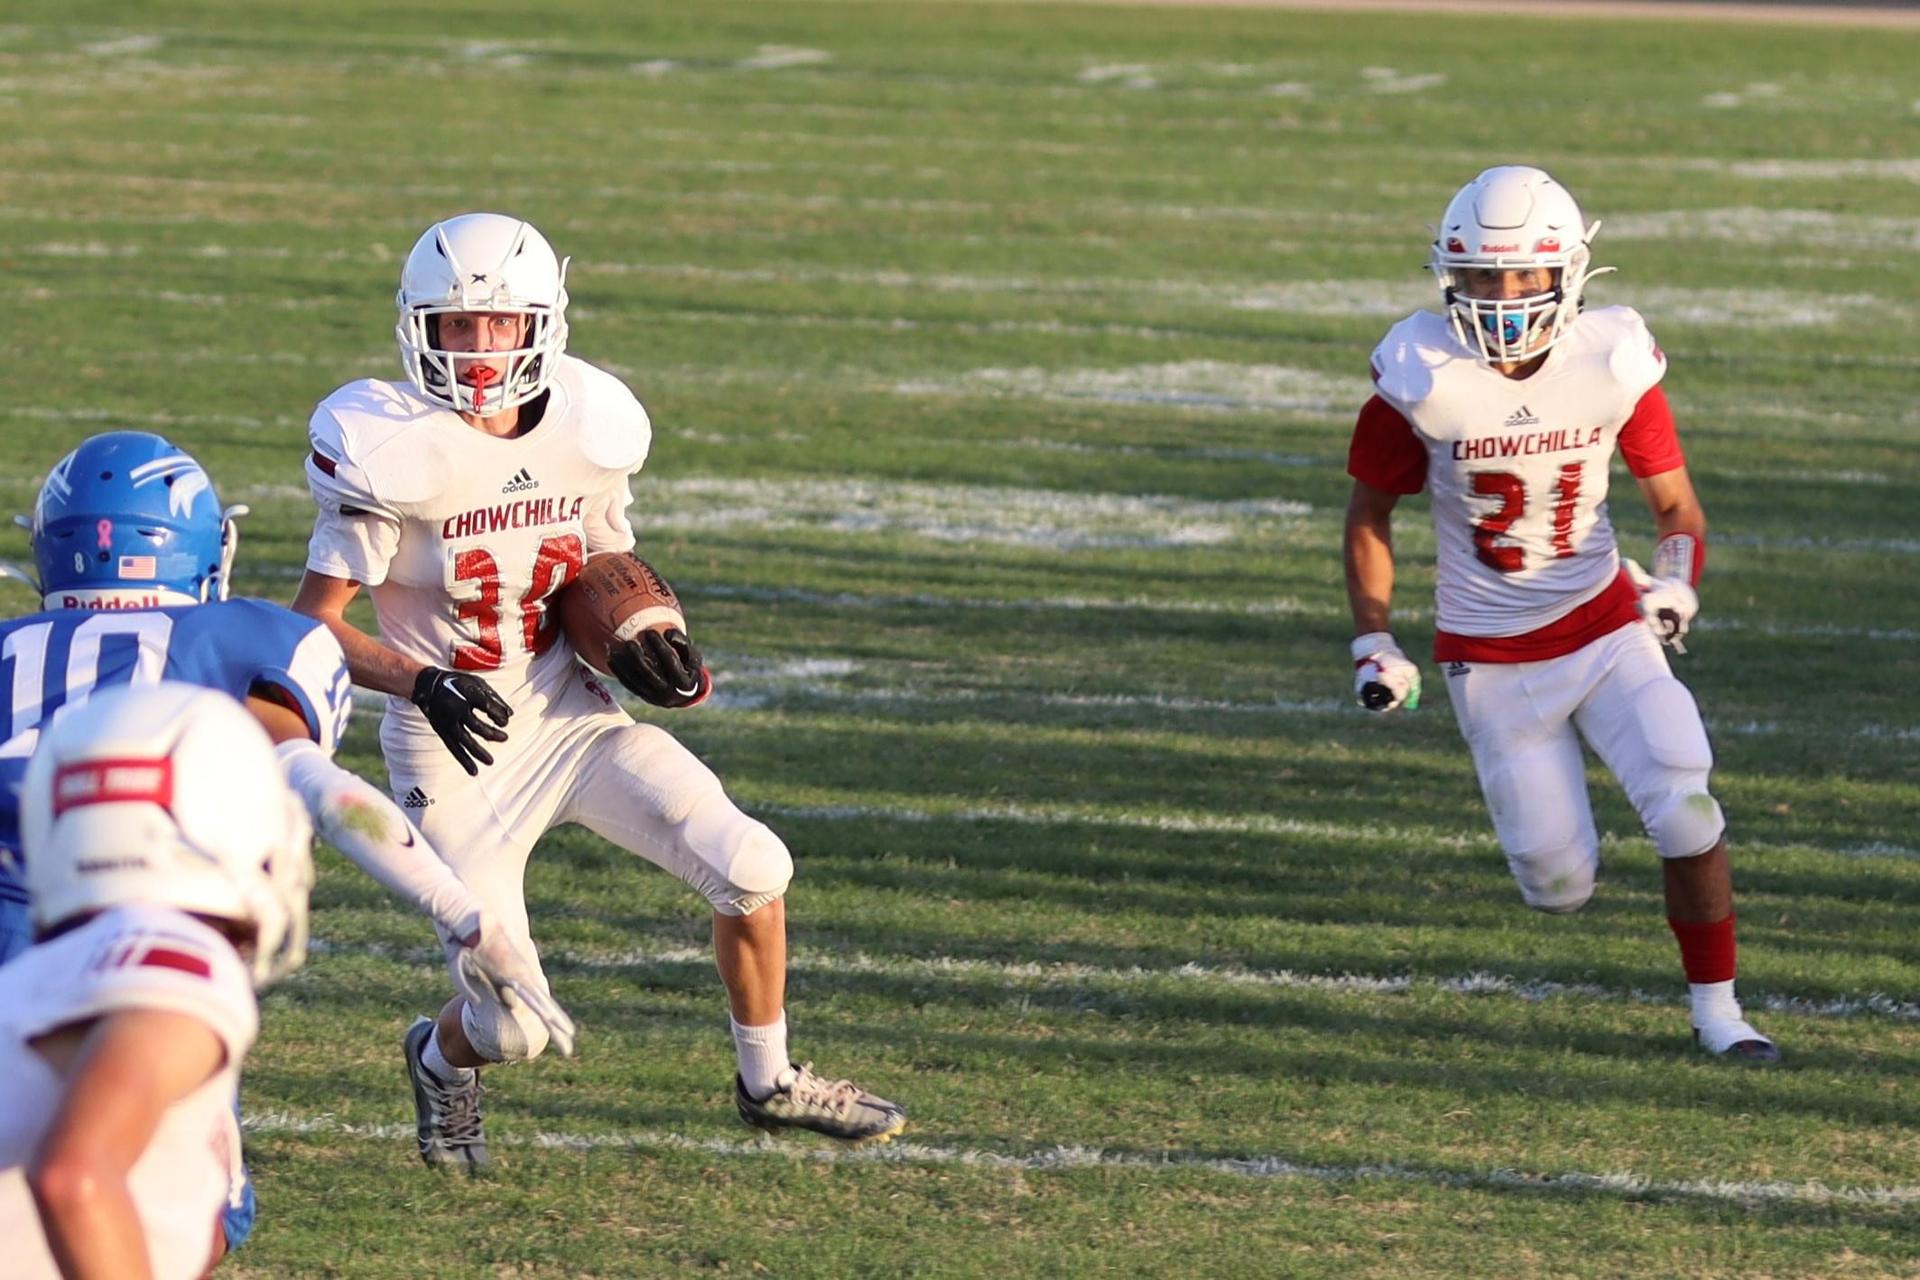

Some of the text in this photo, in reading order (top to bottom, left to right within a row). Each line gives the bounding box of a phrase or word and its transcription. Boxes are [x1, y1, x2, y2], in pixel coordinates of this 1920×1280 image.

[1452, 426, 1602, 461] CHOWCHILLA
[502, 480, 539, 494] adidas
[442, 496, 584, 540] CHOWCHILLA
[1468, 461, 1586, 573] 21
[0, 611, 174, 758] 10
